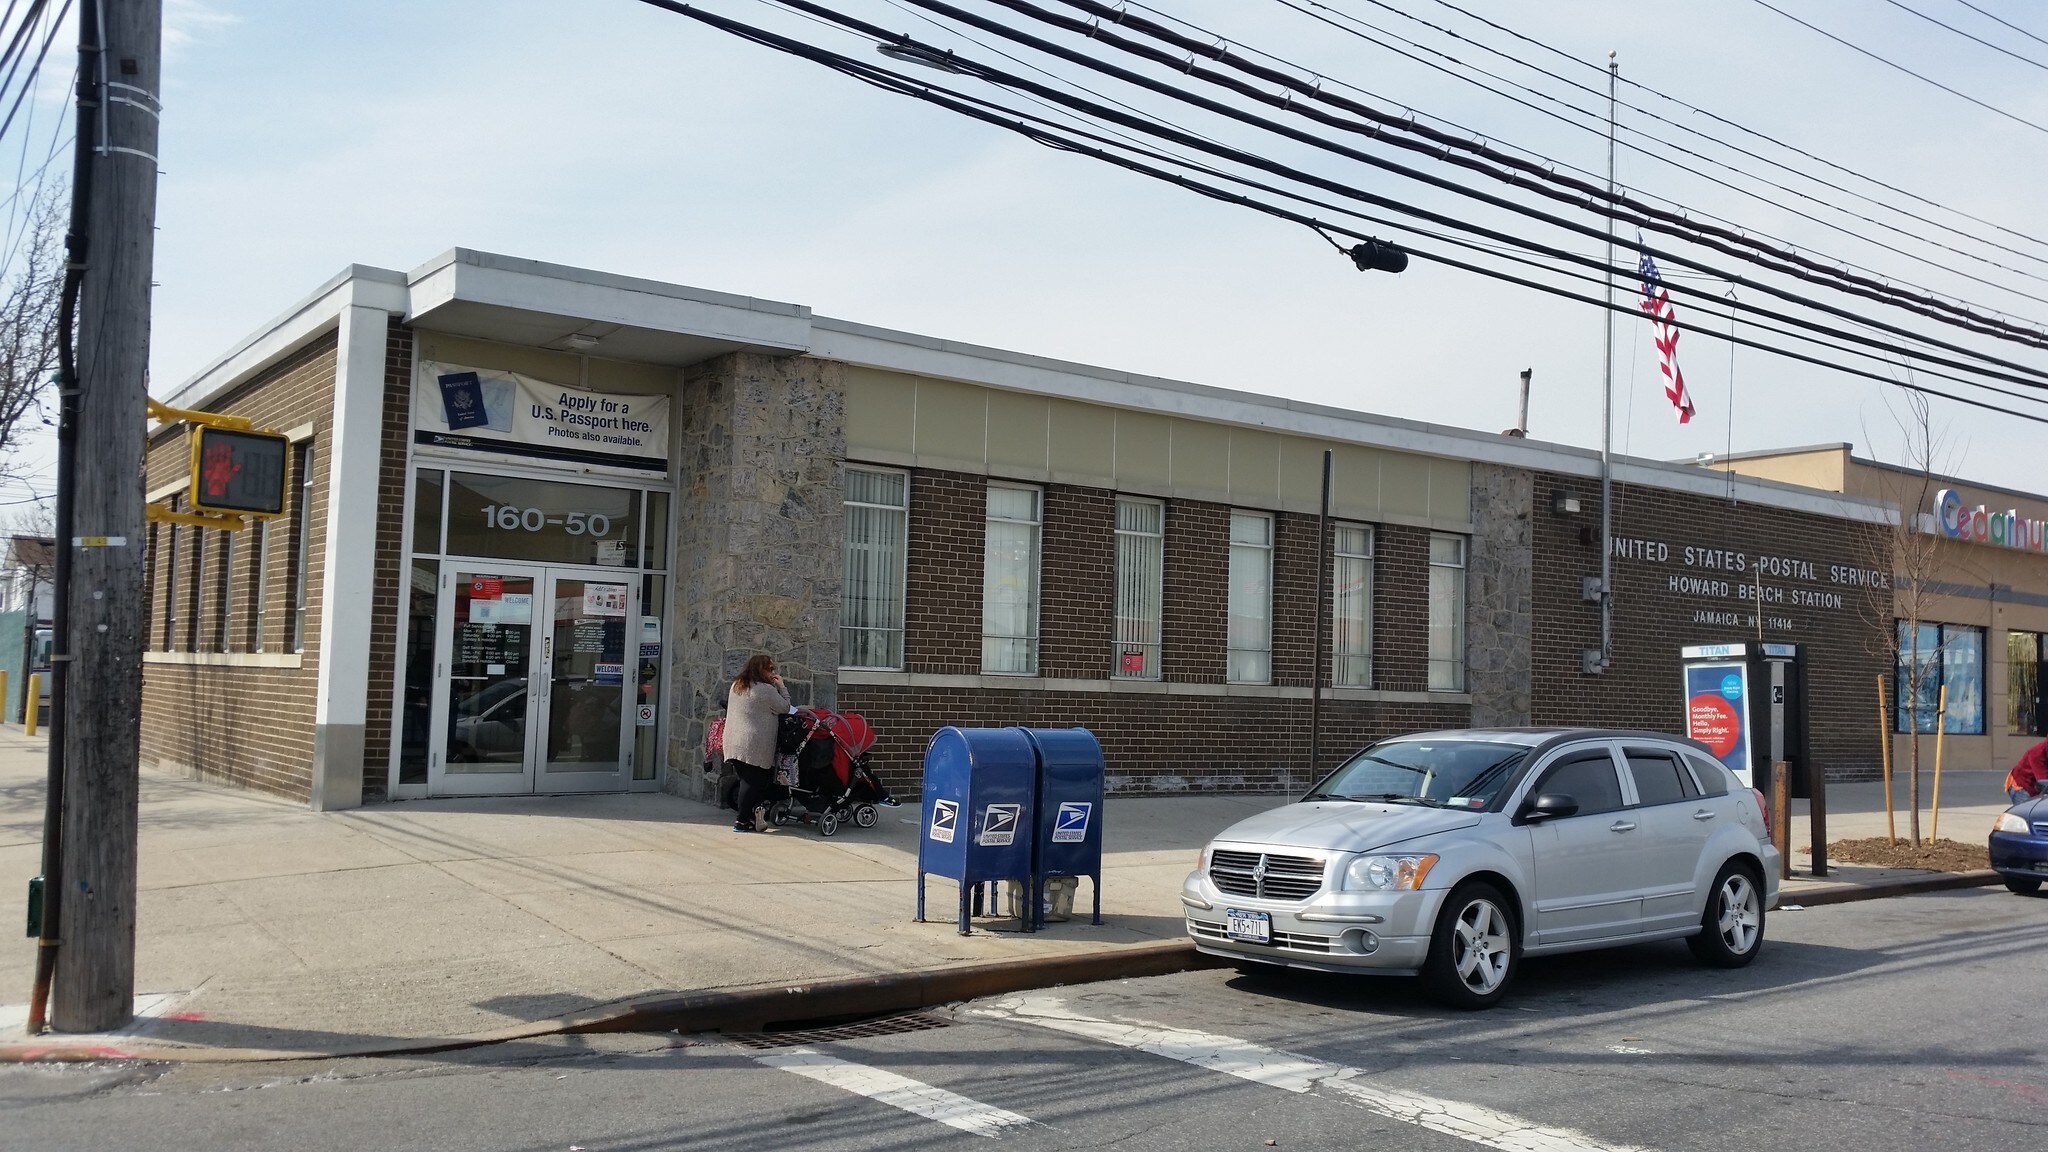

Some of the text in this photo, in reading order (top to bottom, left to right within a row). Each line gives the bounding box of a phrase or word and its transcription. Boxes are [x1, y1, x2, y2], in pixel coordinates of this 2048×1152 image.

[558, 392, 629, 414] Apply for a
[531, 405, 653, 433] U.S. Passport here.
[548, 426, 643, 447] Photos also available.
[480, 504, 610, 538] 160-50
[1684, 546, 1746, 572] STATES
[1760, 555, 1817, 581] POSTAL
[1830, 565, 1888, 589] SERVICE
[504, 597, 529, 605] WELCOME
[1669, 575, 1842, 609] HOWARD BEACH STATION
[1693, 611, 1739, 626] JAMAICA
[1768, 617, 1792, 630] 11414
[1699, 646, 1730, 656] TITAN
[1768, 645, 1787, 655] TITAN
[596, 665, 622, 674] WELCOME
[1692, 713, 1716, 721] Monthly
[1693, 727, 1711, 735] Simply
